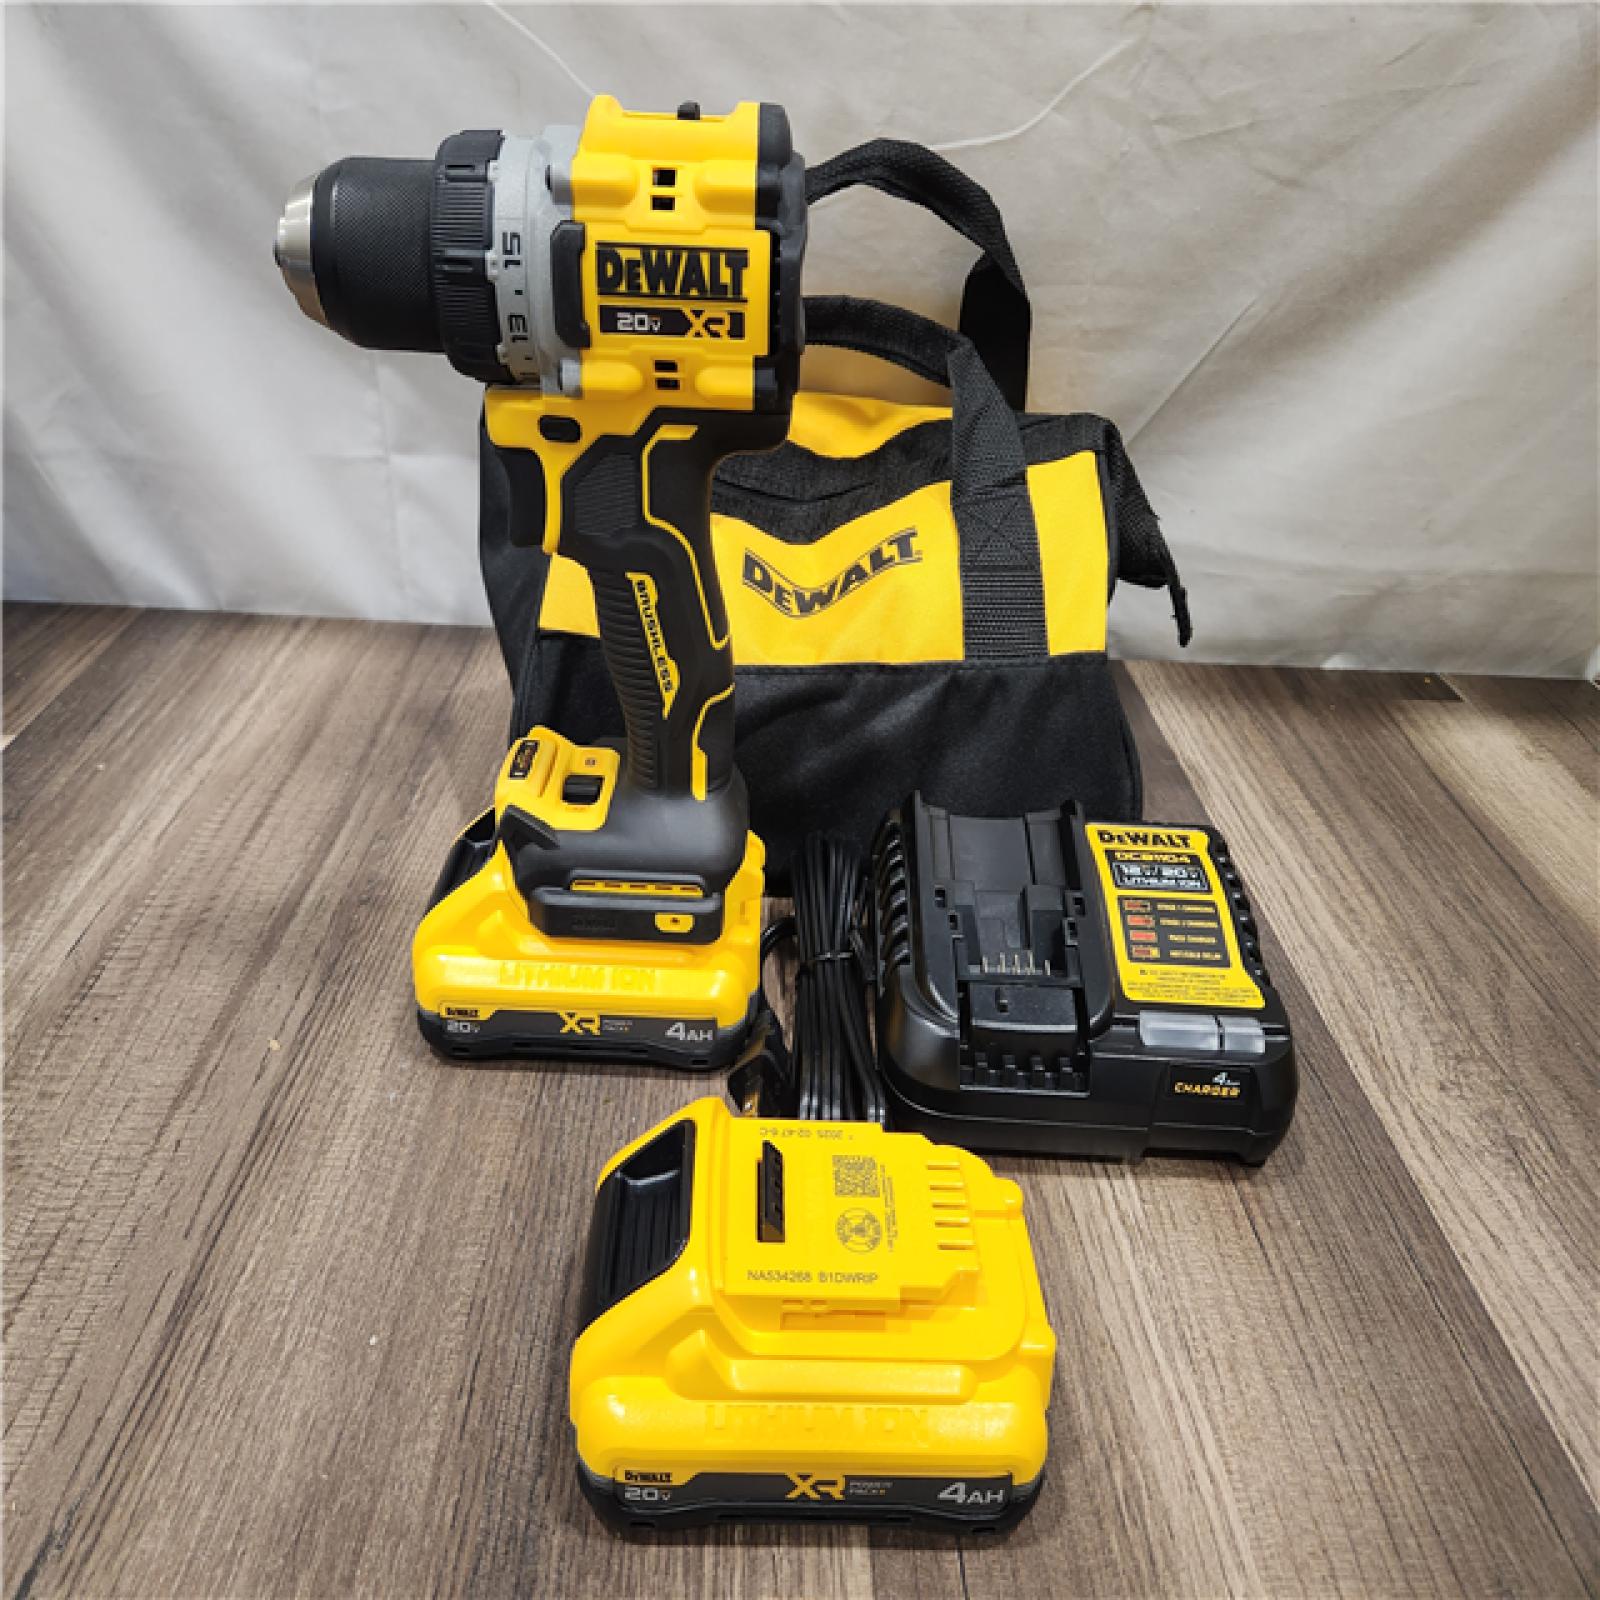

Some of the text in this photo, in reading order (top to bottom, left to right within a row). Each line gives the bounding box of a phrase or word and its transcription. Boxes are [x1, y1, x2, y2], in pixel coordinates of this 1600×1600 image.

[502, 231, 522, 270] 15
[743, 527, 921, 617] DEWALT
[1097, 829, 1192, 849] DEWALT
